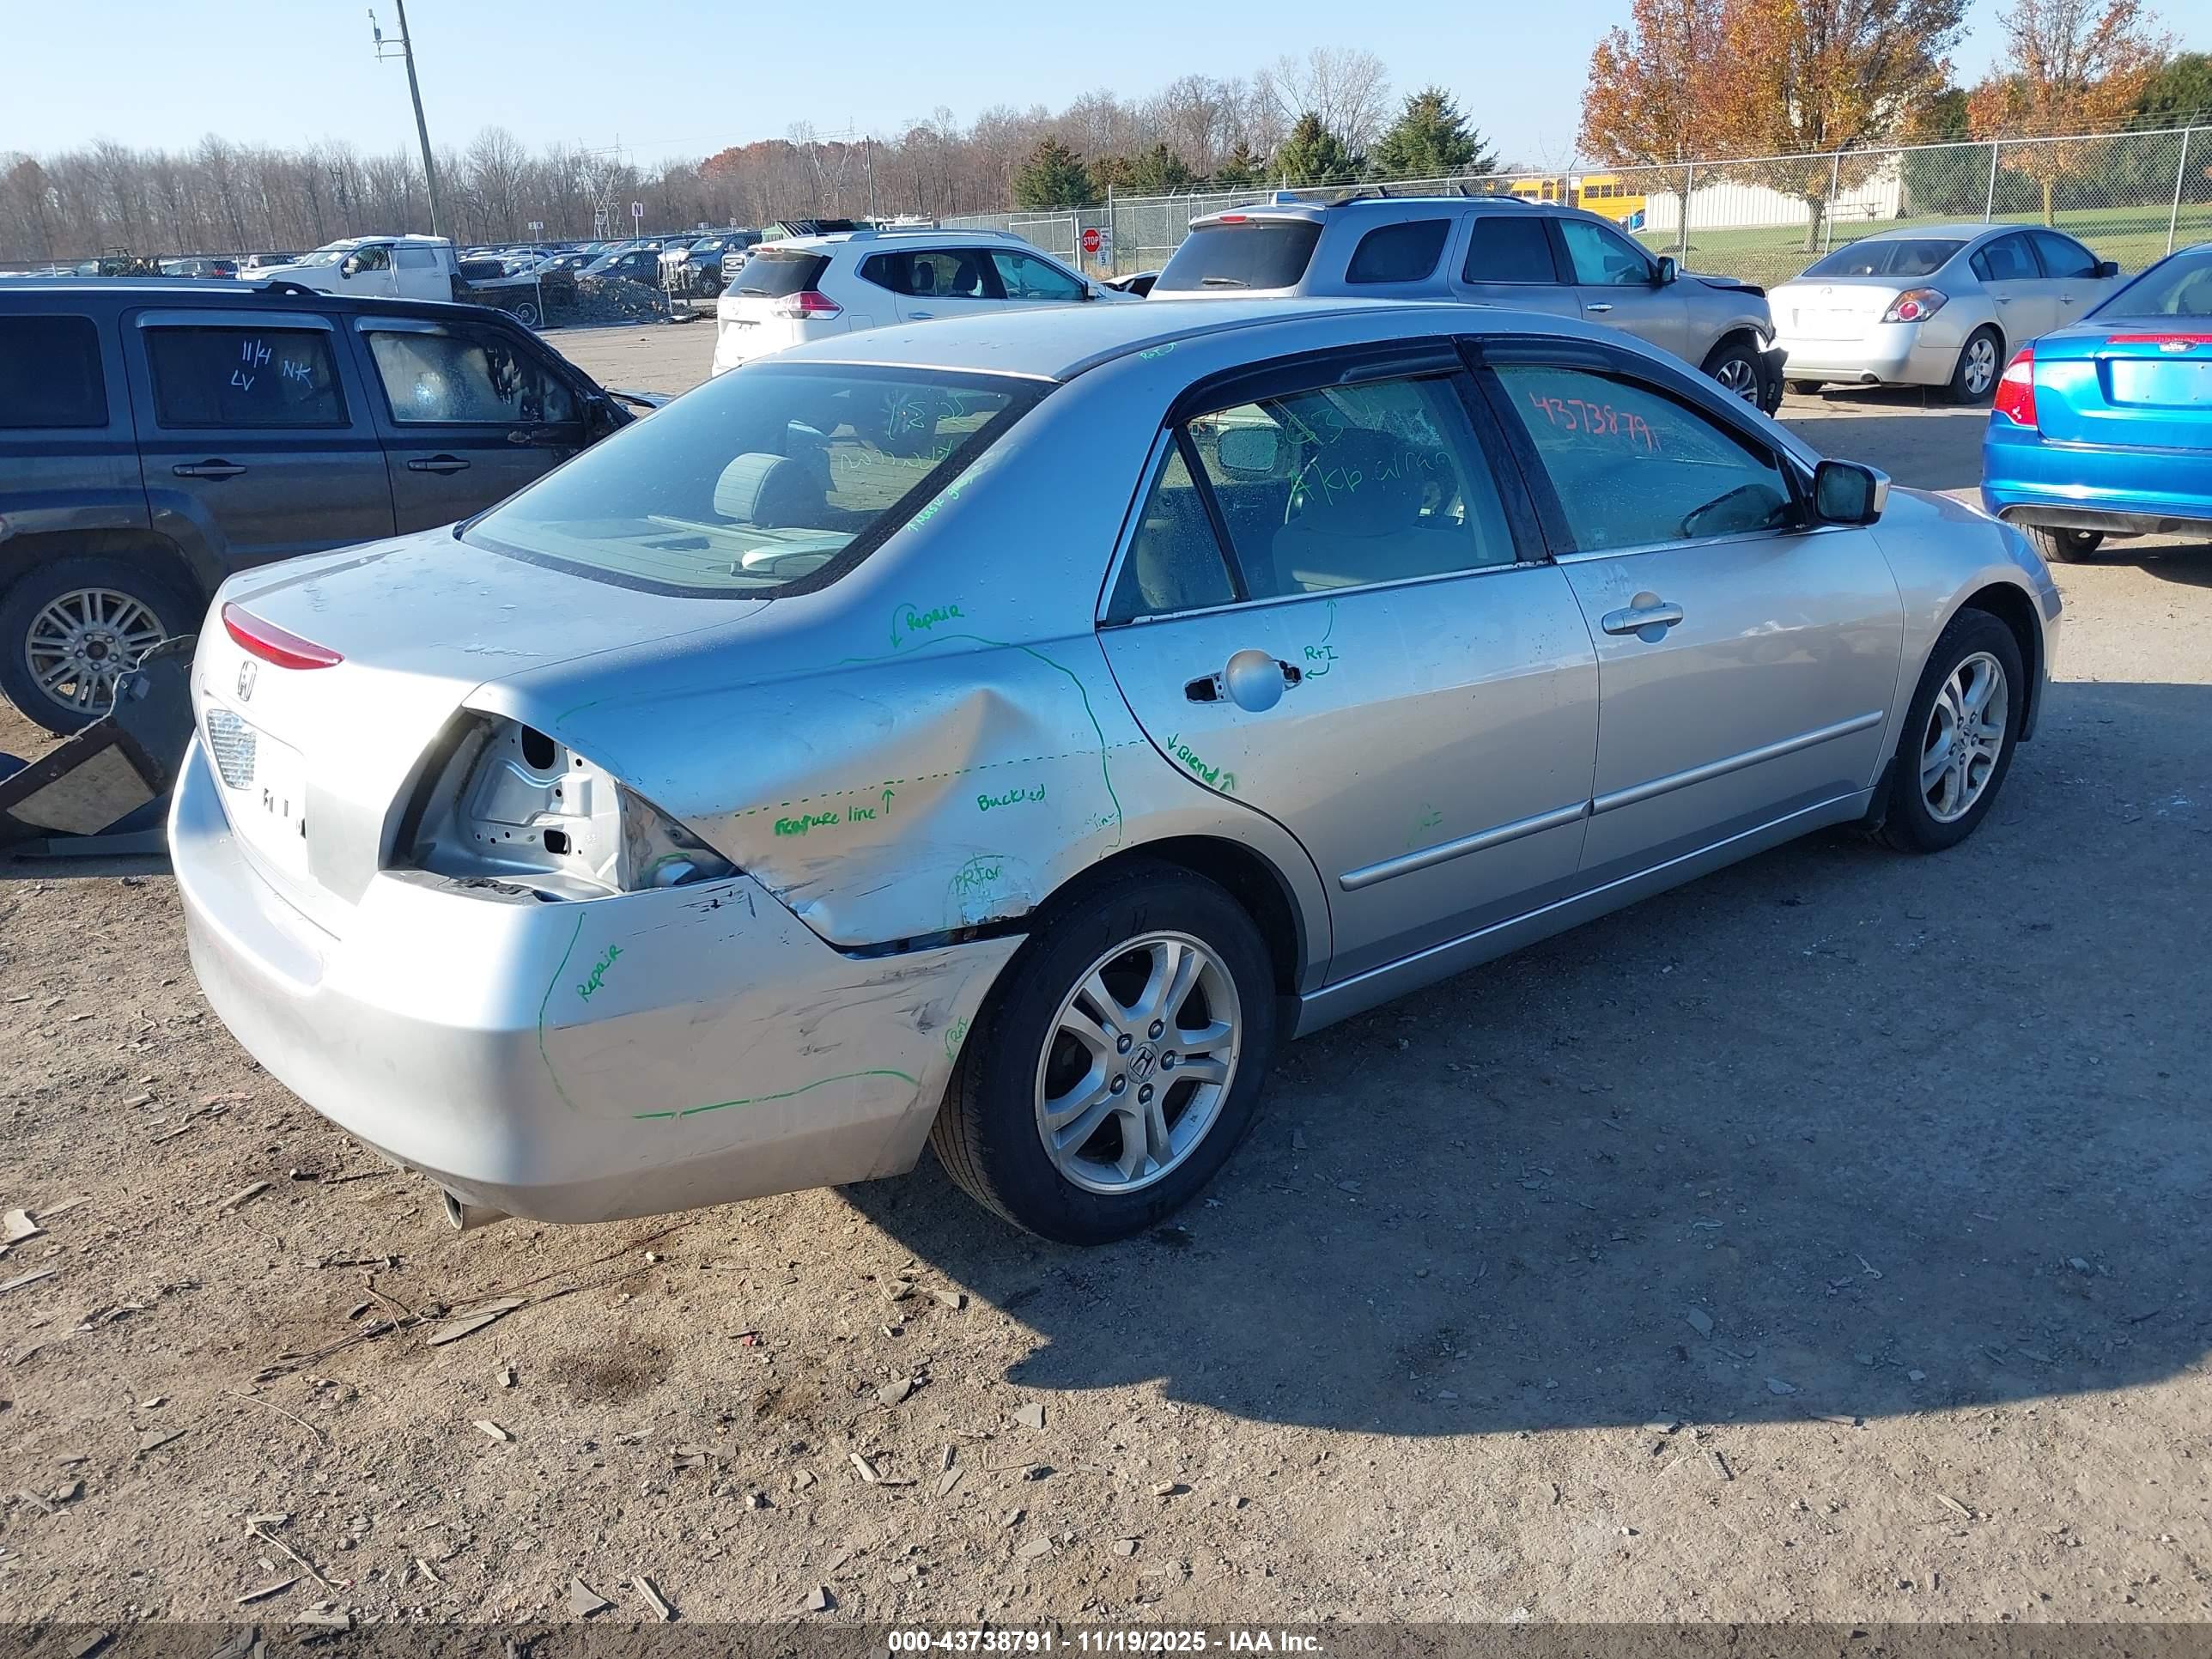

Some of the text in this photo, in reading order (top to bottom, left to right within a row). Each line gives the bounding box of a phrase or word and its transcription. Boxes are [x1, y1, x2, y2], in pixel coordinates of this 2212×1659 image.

[634, 204, 641, 215] N
[1083, 235, 1099, 246] STOP
[241, 338, 272, 368] 11/4
[1529, 392, 1662, 453] 43738791
[1176, 744, 1220, 785] Blend
[848, 805, 877, 822] line
